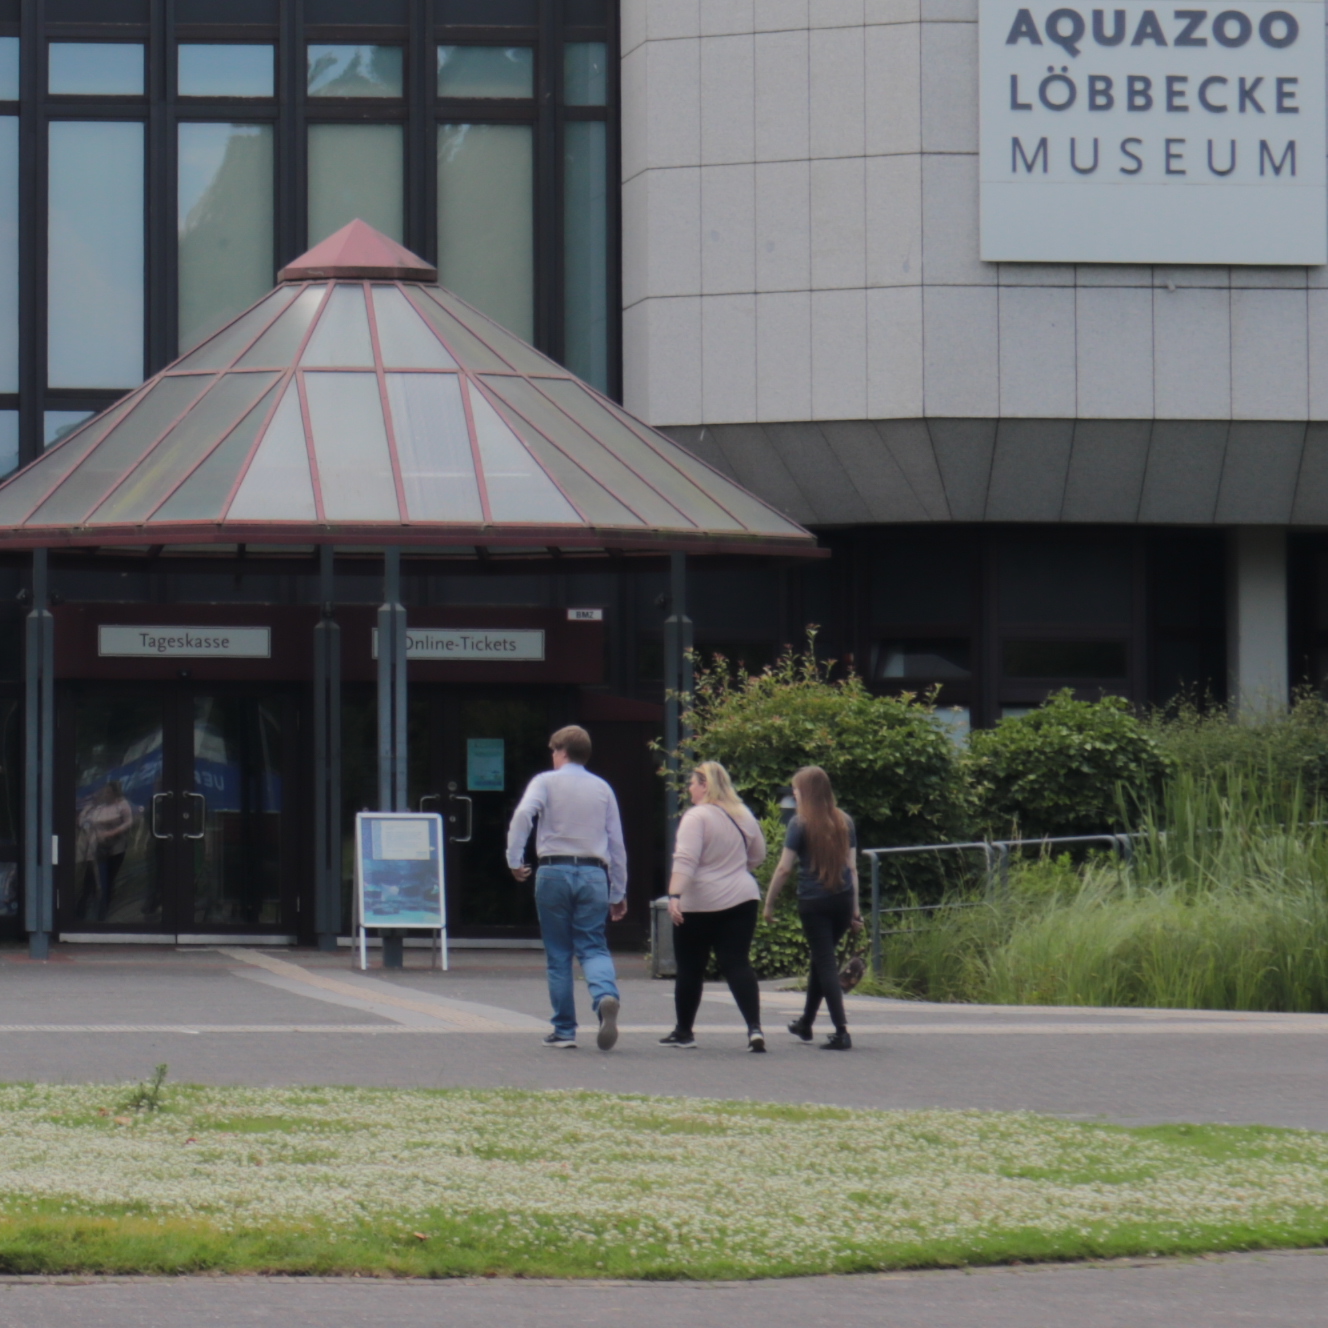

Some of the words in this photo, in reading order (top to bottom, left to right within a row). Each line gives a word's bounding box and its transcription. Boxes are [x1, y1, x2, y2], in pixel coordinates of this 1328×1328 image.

[1005, 8, 1300, 58] AQUAZOO
[1010, 65, 1300, 114] LÖBBECKE
[1011, 136, 1297, 176] MUSEUM
[576, 611, 594, 619] BMZ
[139, 633, 230, 653] Tageskasse
